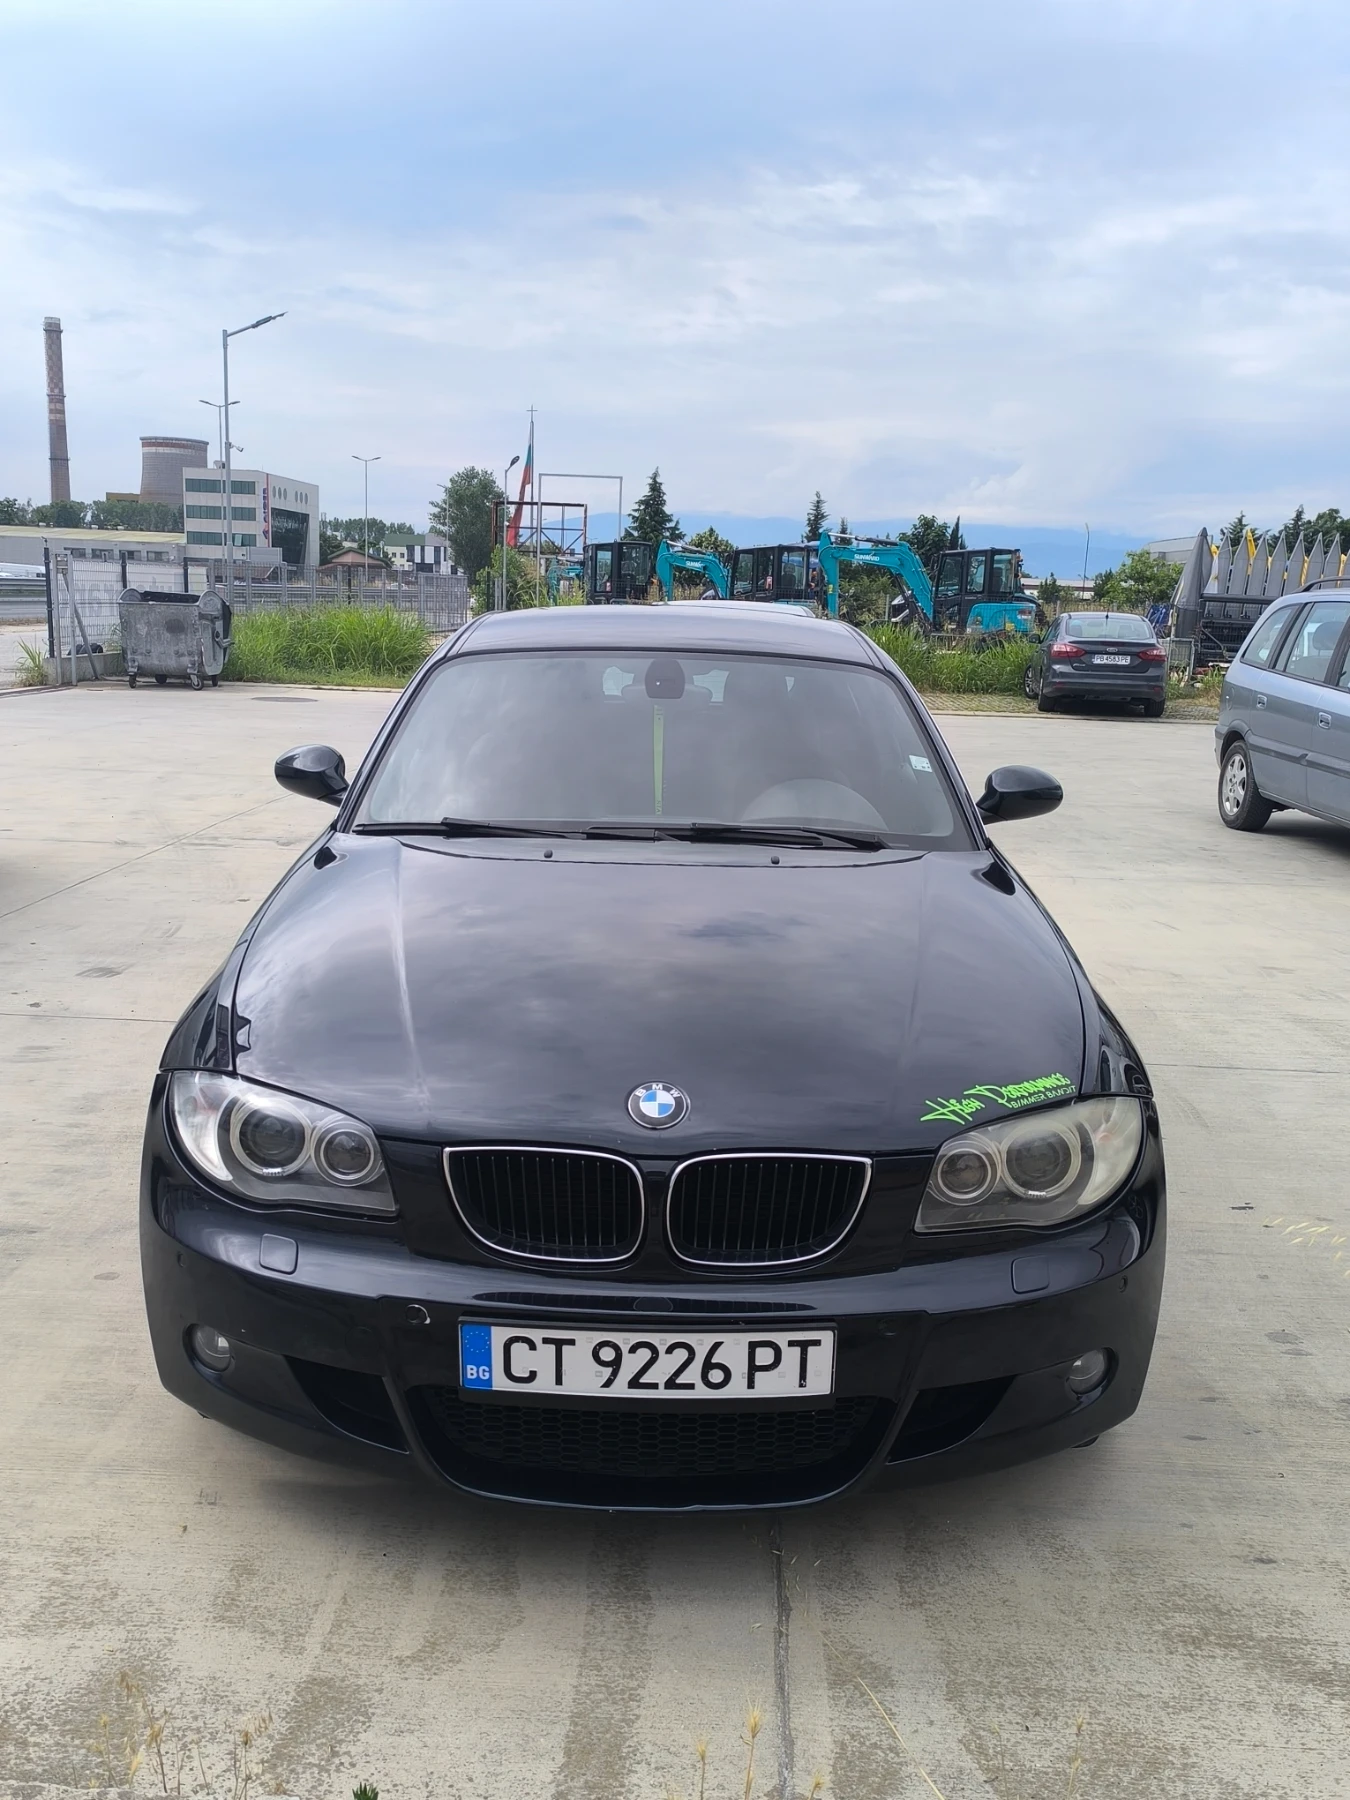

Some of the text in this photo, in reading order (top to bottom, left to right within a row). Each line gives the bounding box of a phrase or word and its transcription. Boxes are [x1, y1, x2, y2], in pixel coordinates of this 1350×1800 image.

[634, 1083, 681, 1098] BMW
[1011, 1085, 1077, 1109] BIMMER BANDIT
[466, 1364, 490, 1381] BG
[503, 1335, 822, 1391] CT 9226 PT
